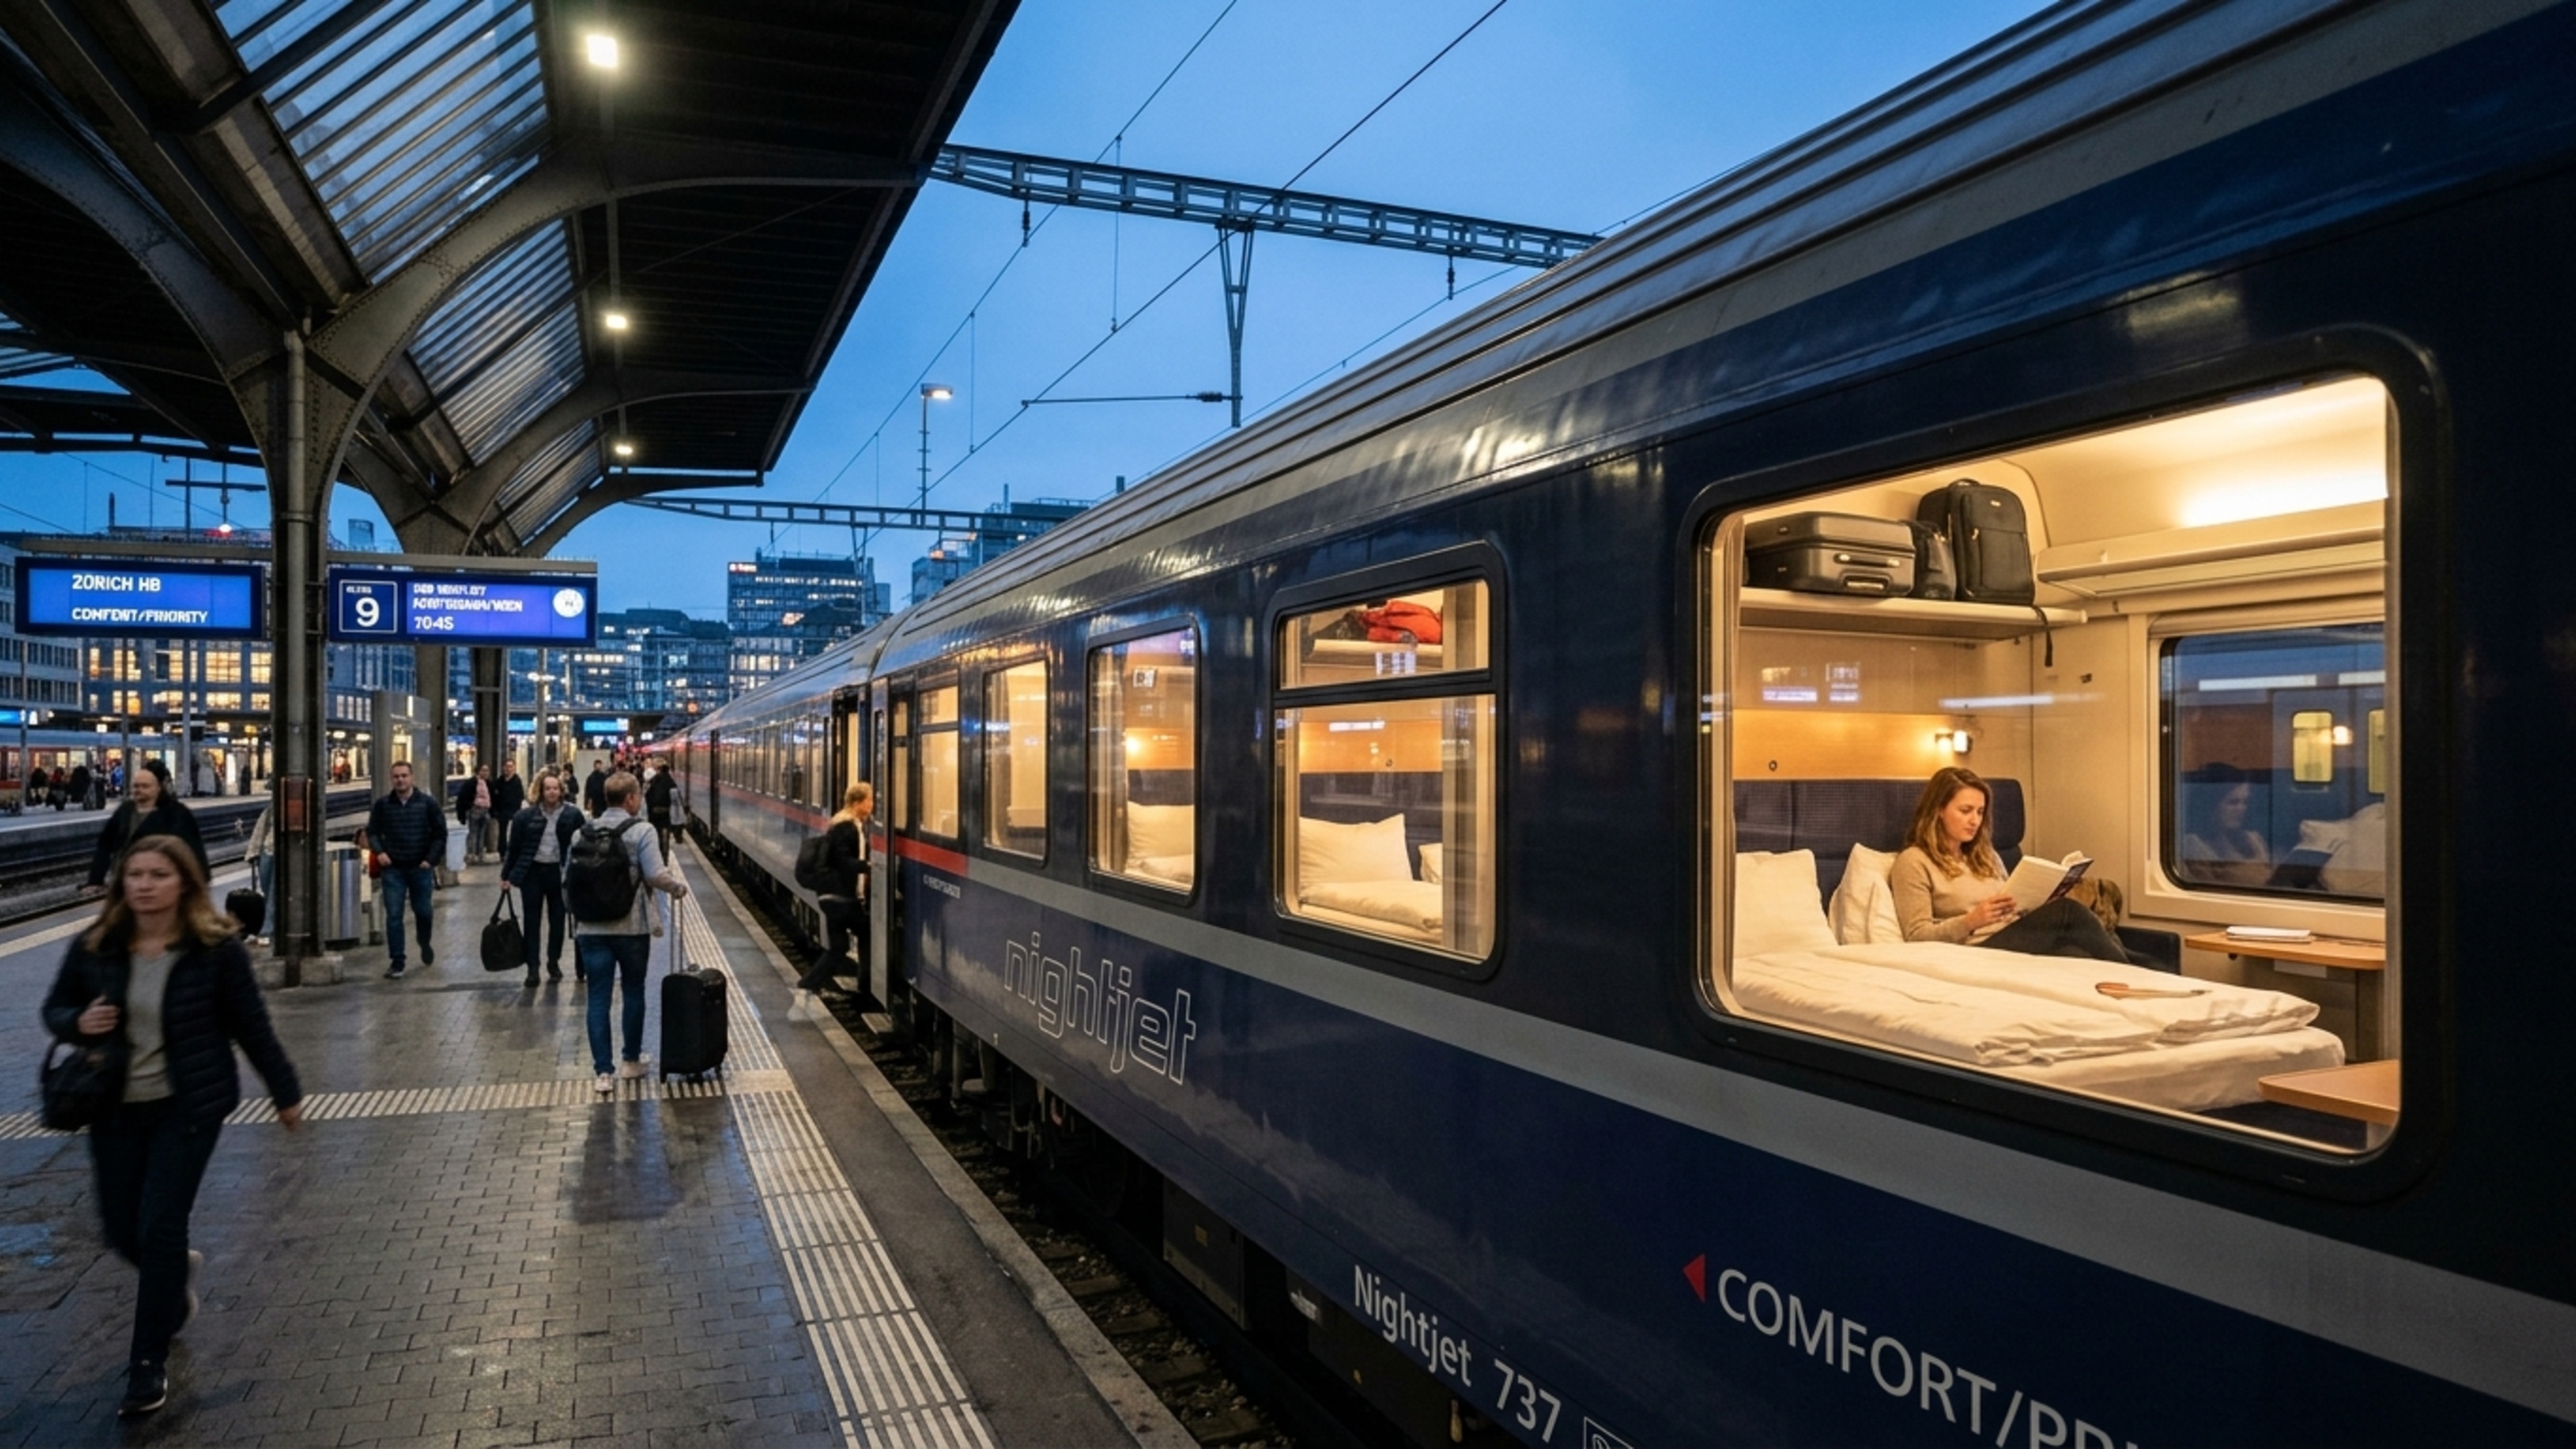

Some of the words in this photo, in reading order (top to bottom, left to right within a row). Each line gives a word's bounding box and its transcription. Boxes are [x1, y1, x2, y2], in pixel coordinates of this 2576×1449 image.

[138, 577, 161, 592] HB
[355, 597, 380, 627] 9
[1004, 931, 1197, 1086] nightjet
[1354, 1264, 1472, 1387] Nightjet
[1494, 1359, 1562, 1444] 737
[1717, 1268, 2139, 1449] COMFORT/P
